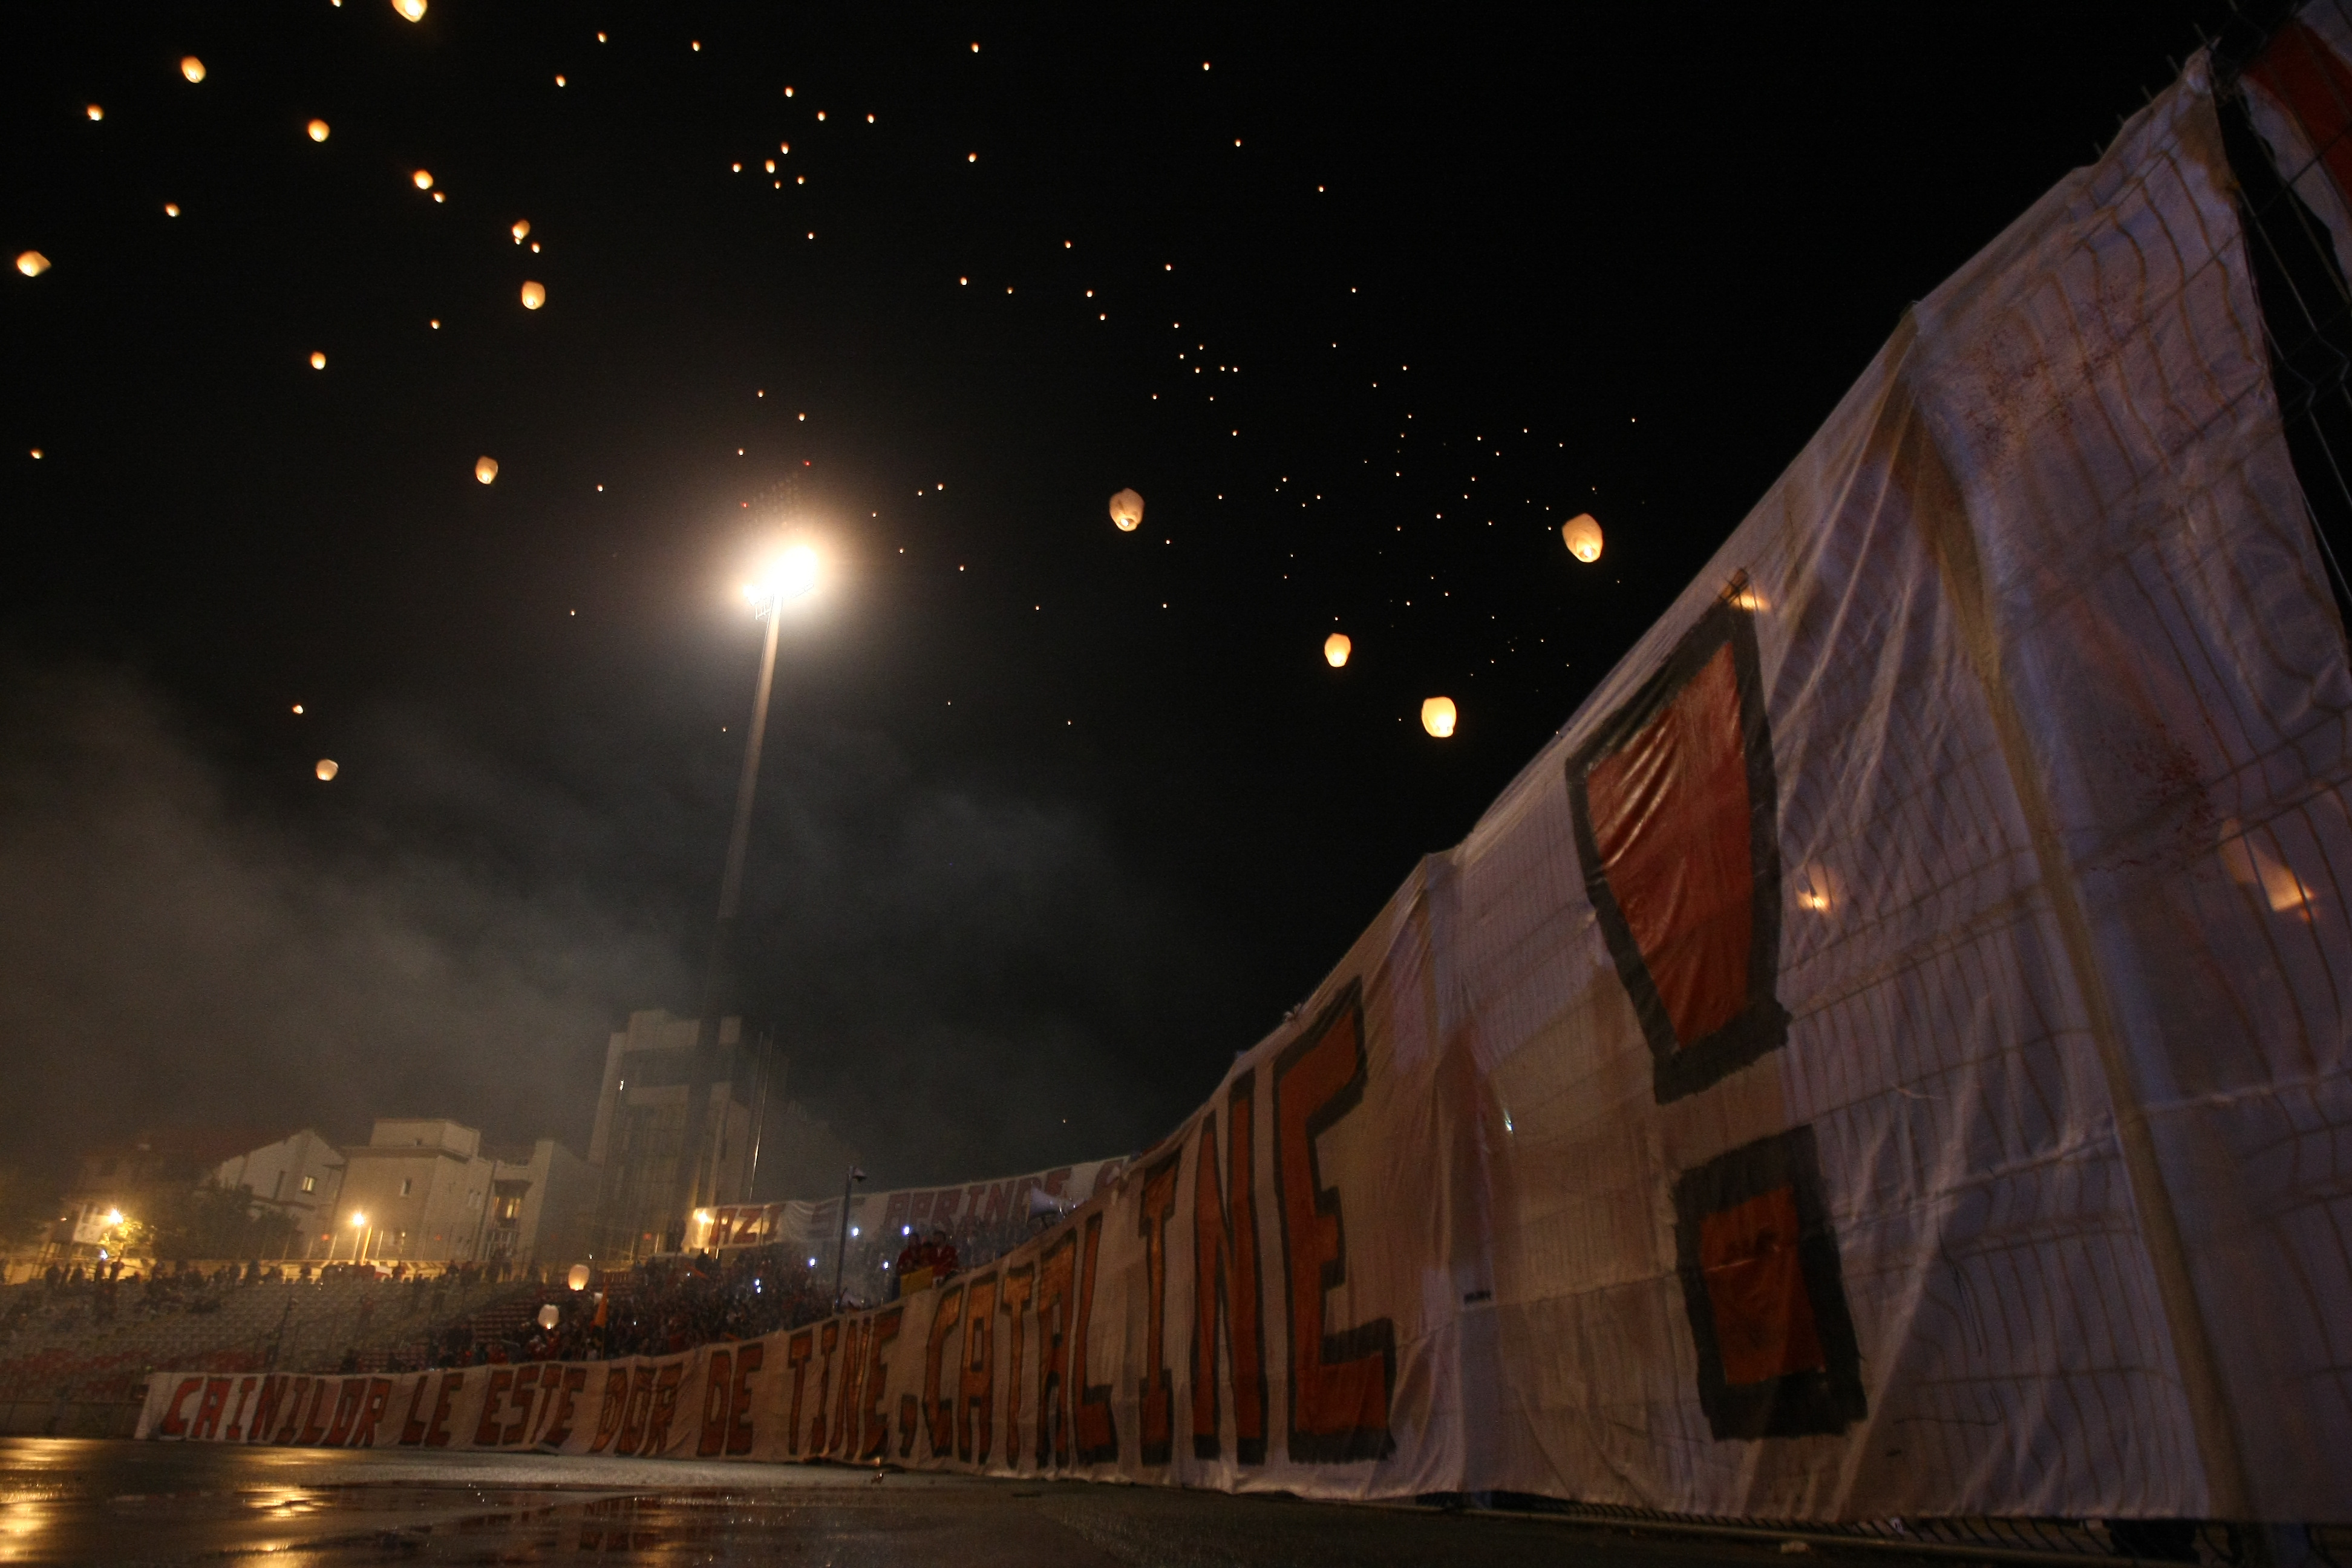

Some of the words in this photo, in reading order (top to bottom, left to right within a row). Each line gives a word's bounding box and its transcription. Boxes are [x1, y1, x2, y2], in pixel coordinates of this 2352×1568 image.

[160, 1375, 392, 1447] CAINILOR
[398, 1371, 465, 1447] LE
[474, 1363, 587, 1448] ESTE
[588, 1362, 684, 1457] DOR
[696, 1342, 764, 1457] DE
